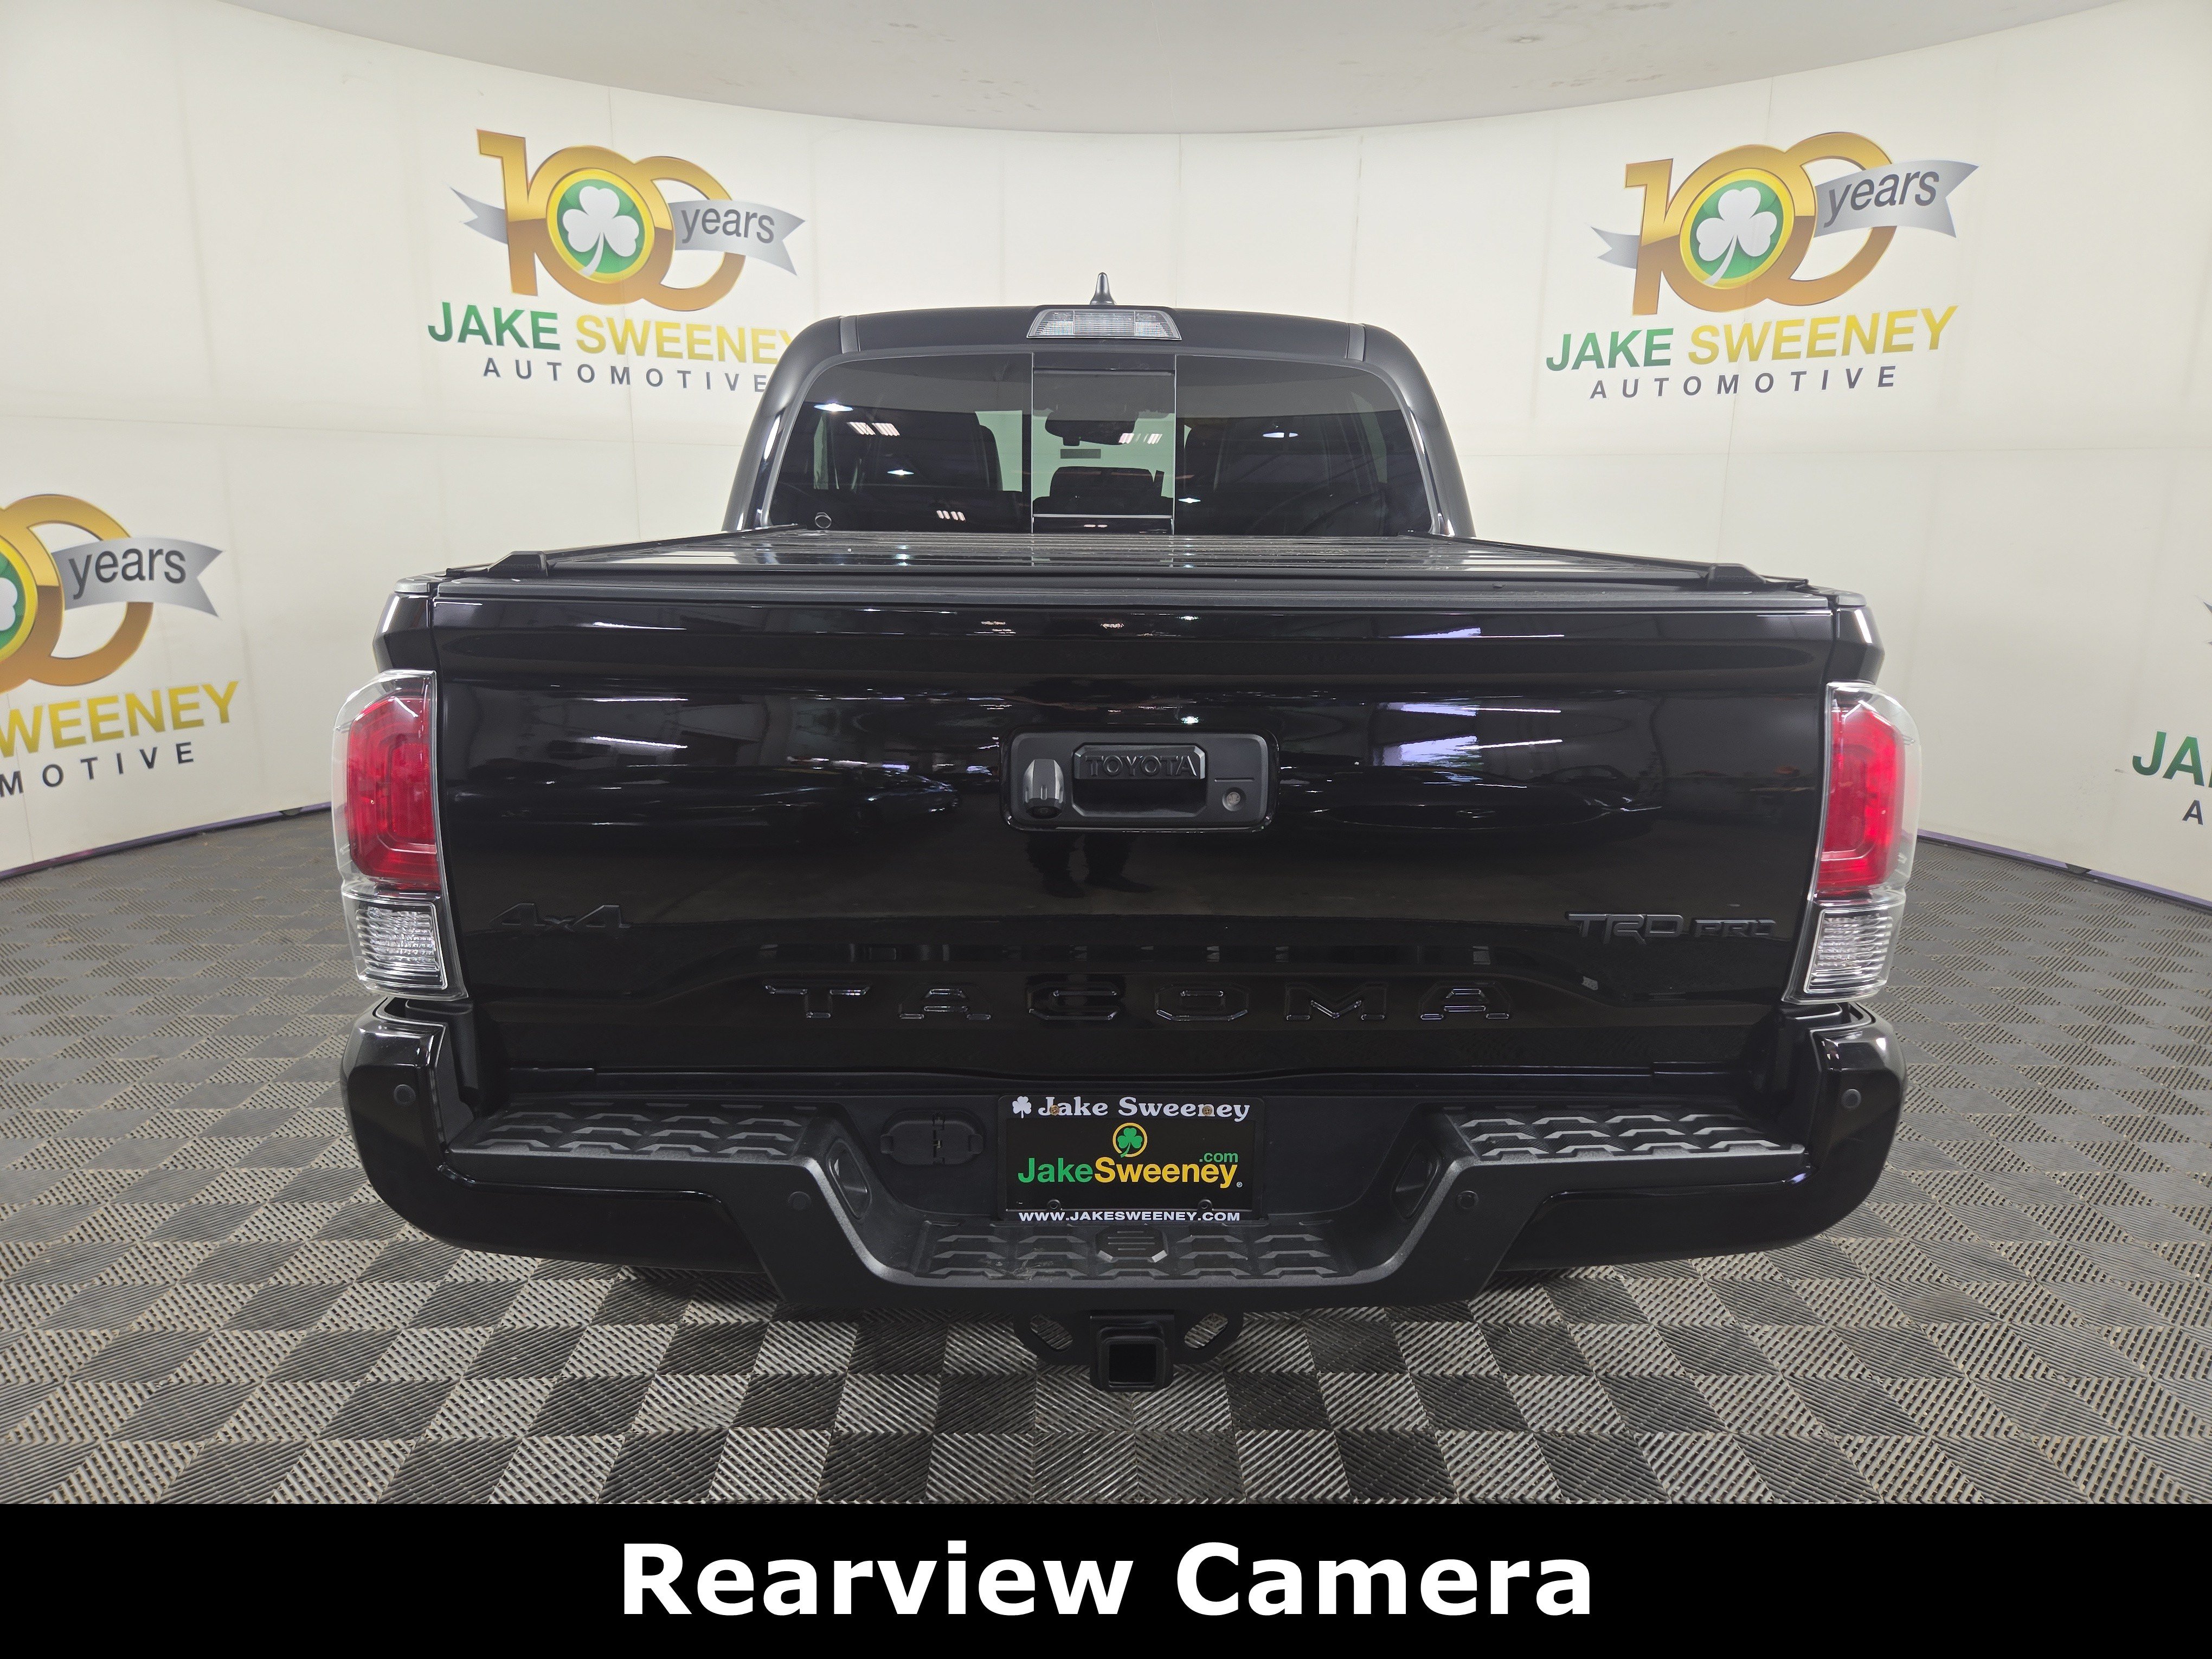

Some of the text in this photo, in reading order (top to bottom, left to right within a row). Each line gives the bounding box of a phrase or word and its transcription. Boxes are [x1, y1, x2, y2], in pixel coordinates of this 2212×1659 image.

[1823, 170, 1940, 228] years
[681, 207, 775, 243] years
[427, 301, 561, 351] JAKE
[1546, 305, 1959, 372] JAKE SWEENEY
[483, 357, 767, 393] AUTOMOTIVE
[1590, 365, 1896, 400] AUTOMOTIVE
[68, 548, 187, 599] years
[0, 680, 239, 758] WEENEY
[0, 741, 194, 798] MOTIVE
[1085, 755, 1198, 777] TOYOTA
[2132, 730, 2212, 788] JA
[1565, 911, 1776, 945] TRD PRO
[762, 980, 1513, 1021] TACOMA
[1038, 1096, 1250, 1122] Jake Sweeney
[1019, 1211, 1240, 1221] WWW.JAKESWEENEY.COM
